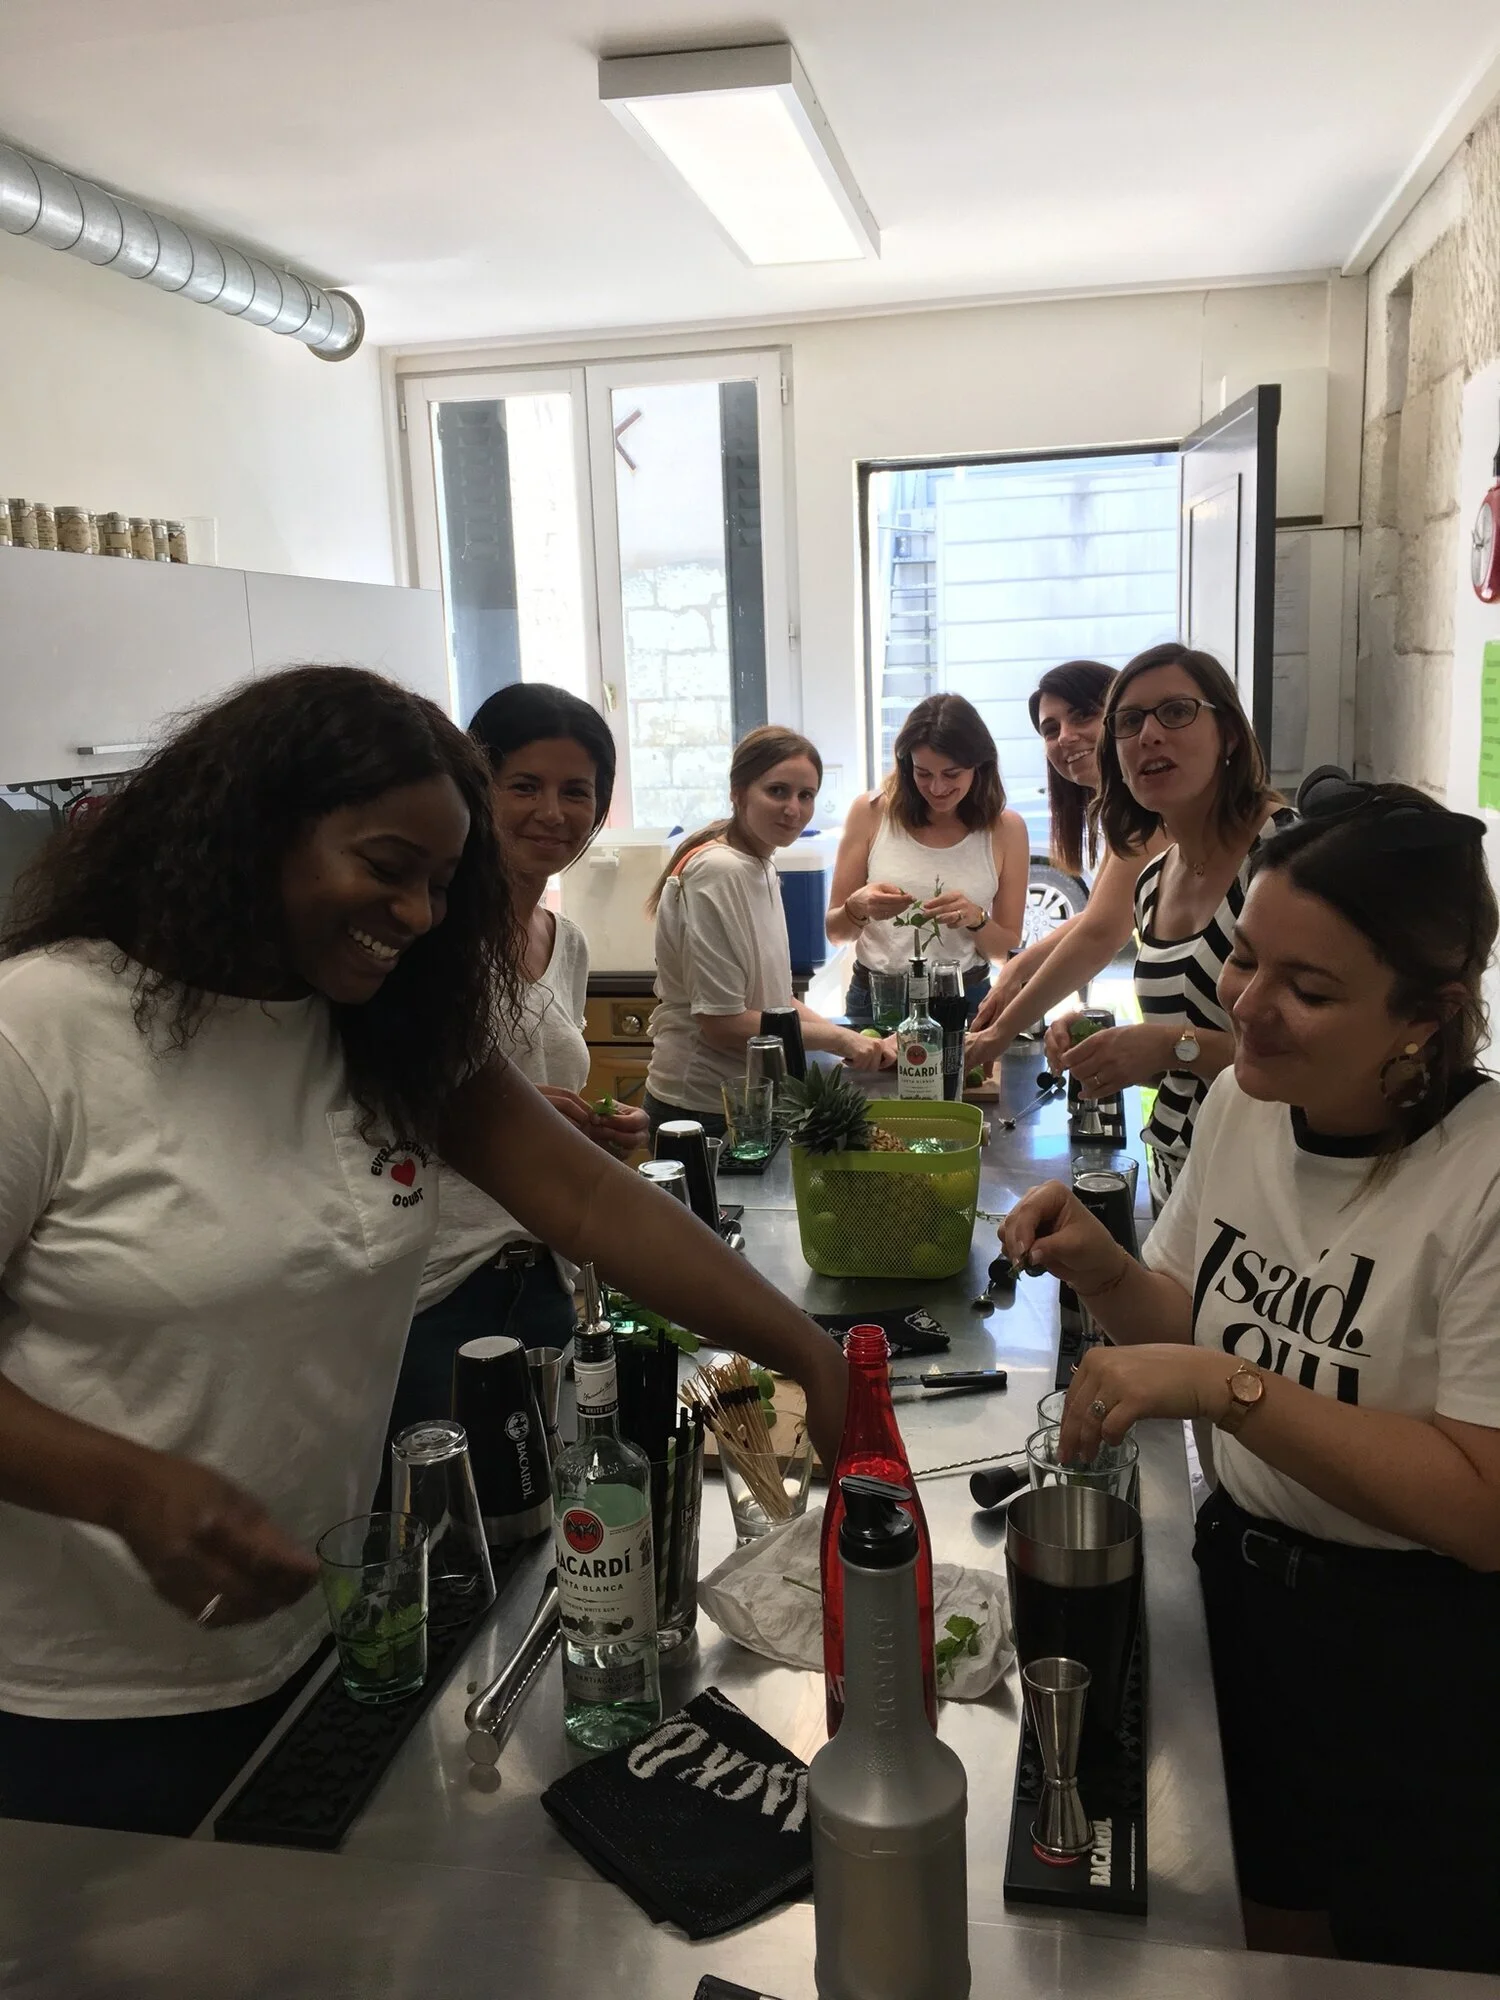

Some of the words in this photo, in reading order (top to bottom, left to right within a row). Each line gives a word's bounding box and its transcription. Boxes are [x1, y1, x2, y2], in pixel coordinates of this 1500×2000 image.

[392, 1187, 424, 1208] DOUBT
[516, 1441, 536, 1497] BACARDÍ
[583, 1583, 624, 1593] BLANCA
